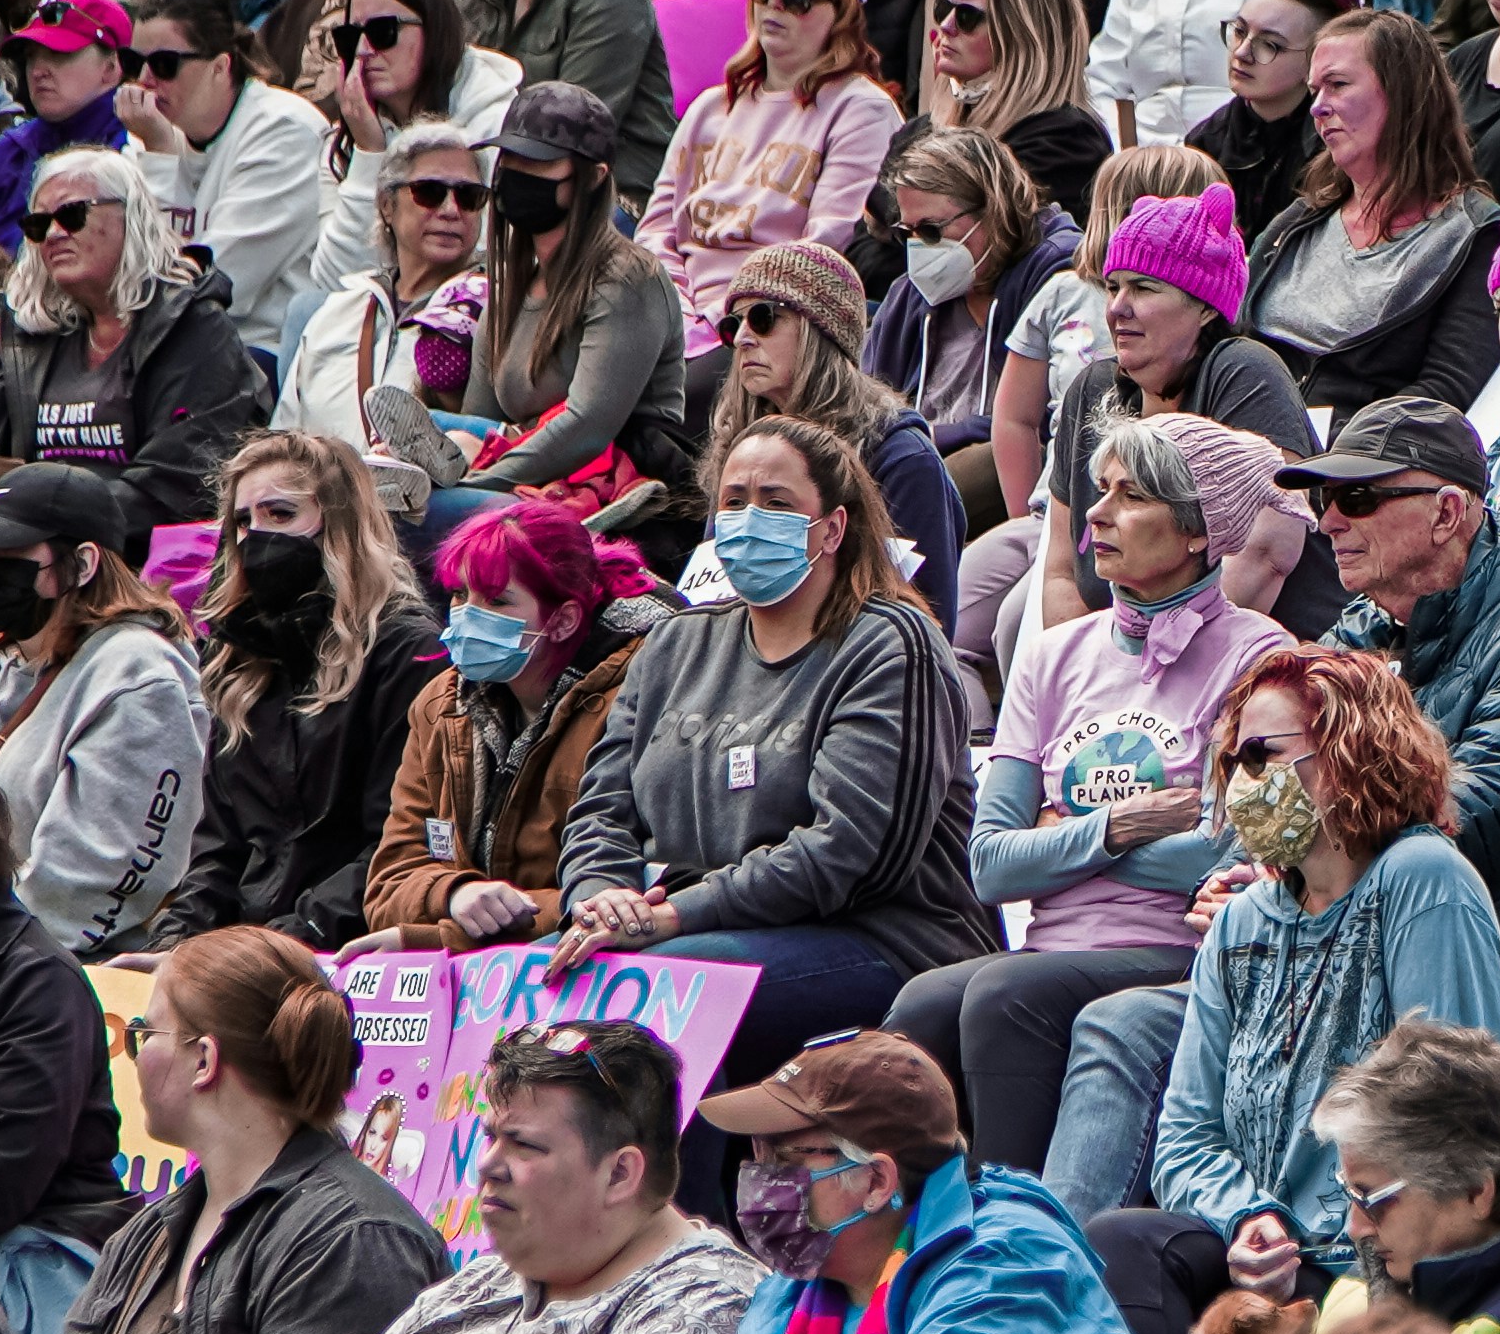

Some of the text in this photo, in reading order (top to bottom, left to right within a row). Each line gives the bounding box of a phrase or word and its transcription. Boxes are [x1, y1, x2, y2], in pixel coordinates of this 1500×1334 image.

[80, 423, 125, 446] HAVE
[1063, 711, 1180, 754] PRO CHOICE
[1094, 769, 1130, 785] PRO
[81, 768, 182, 951] carhartt
[347, 970, 427, 999] ARE YOU
[453, 949, 708, 1043] BORTION
[354, 1016, 428, 1043] OBSESSED
